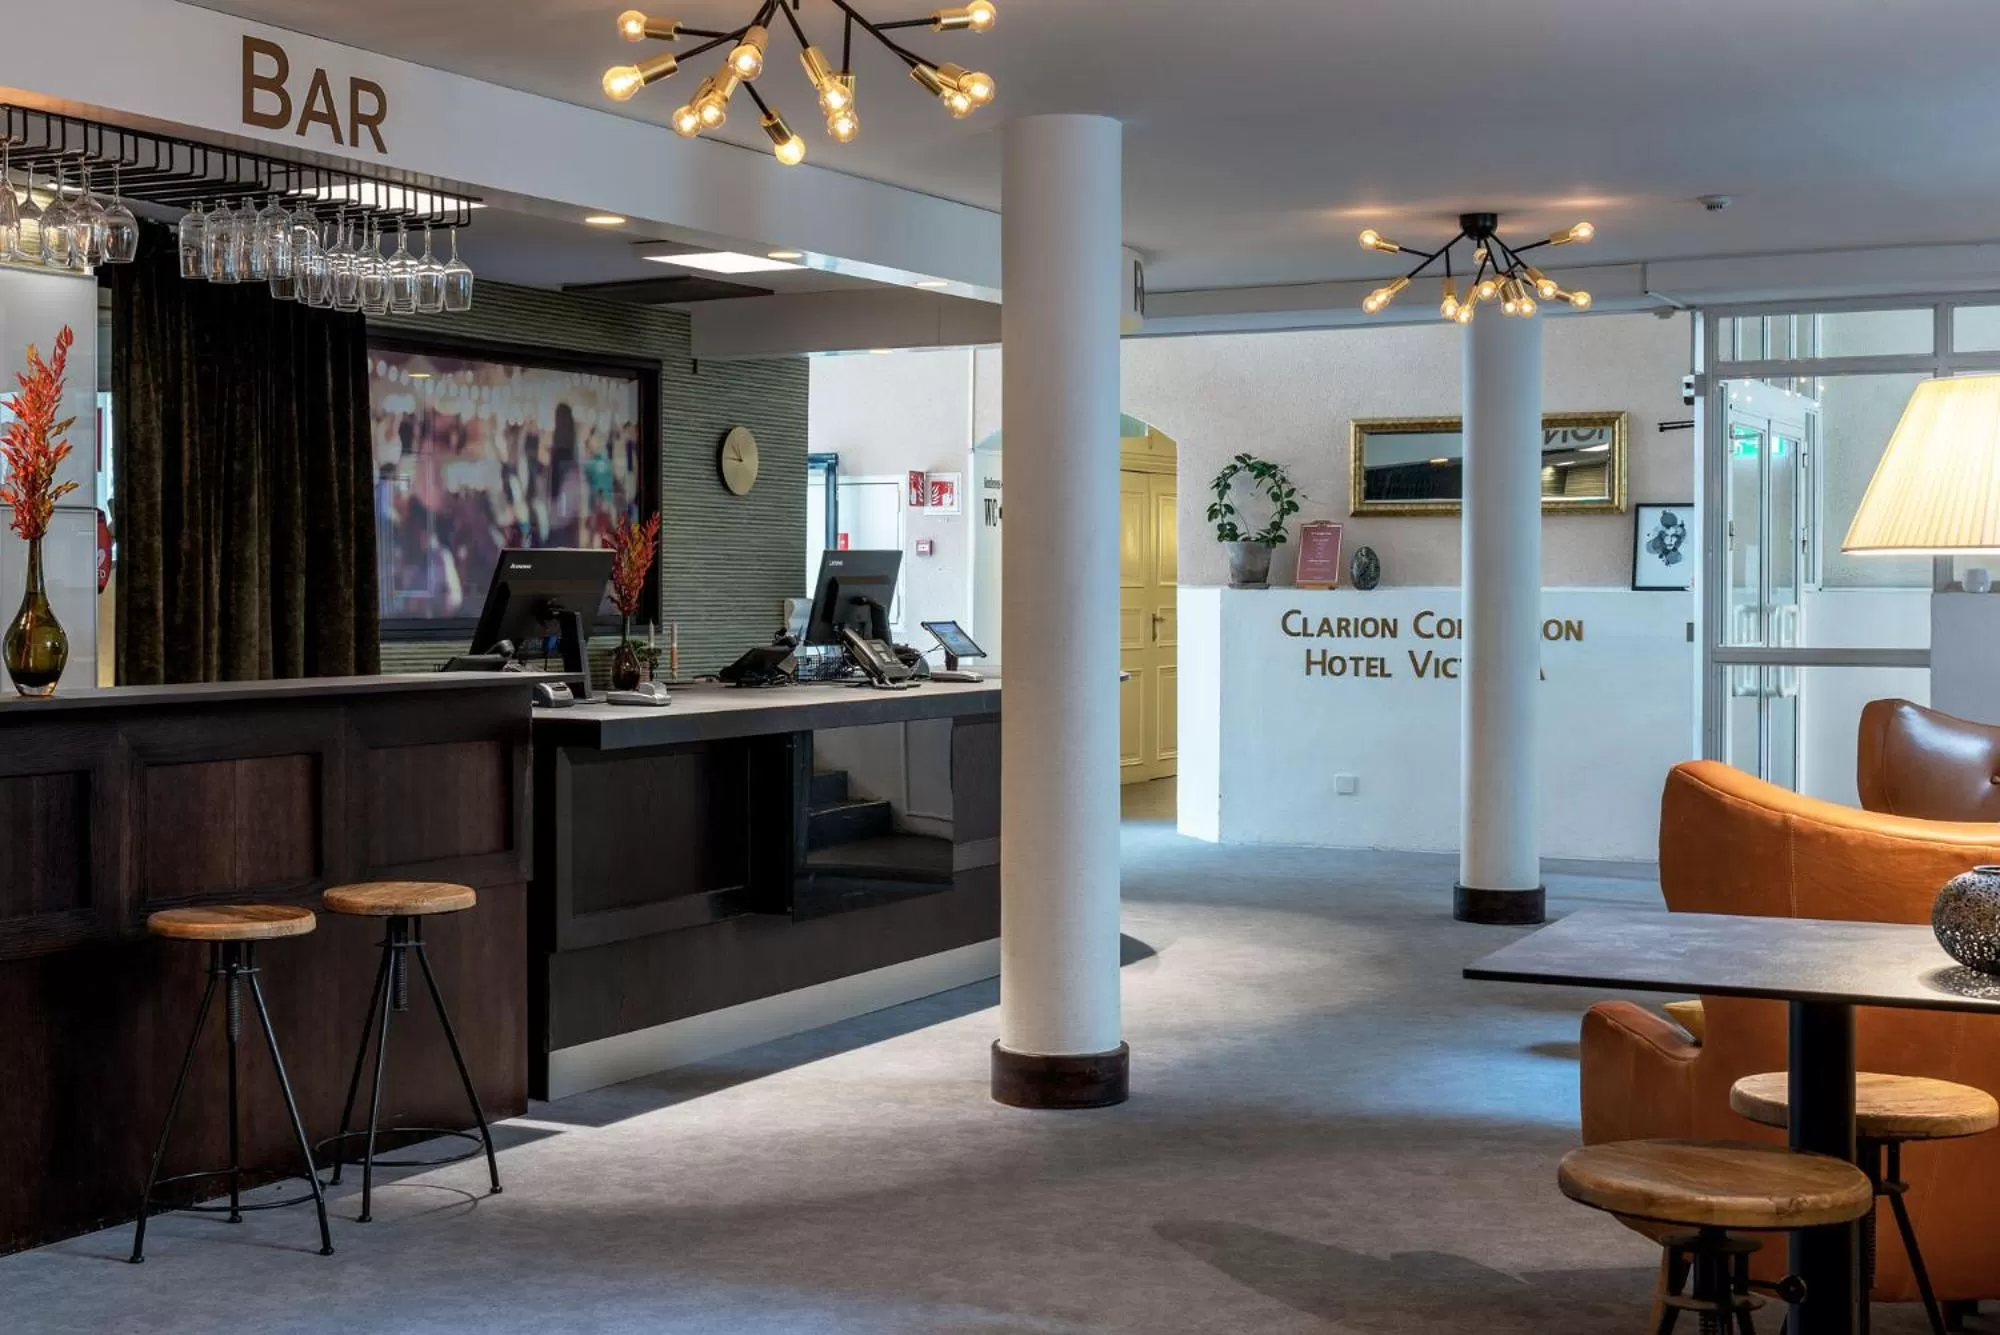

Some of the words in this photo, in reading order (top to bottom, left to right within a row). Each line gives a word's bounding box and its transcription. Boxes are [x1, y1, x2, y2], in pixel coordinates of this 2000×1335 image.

[243, 34, 389, 155] BAR
[1281, 609, 1398, 638] CLARION
[1305, 649, 1392, 678] HOTEL
